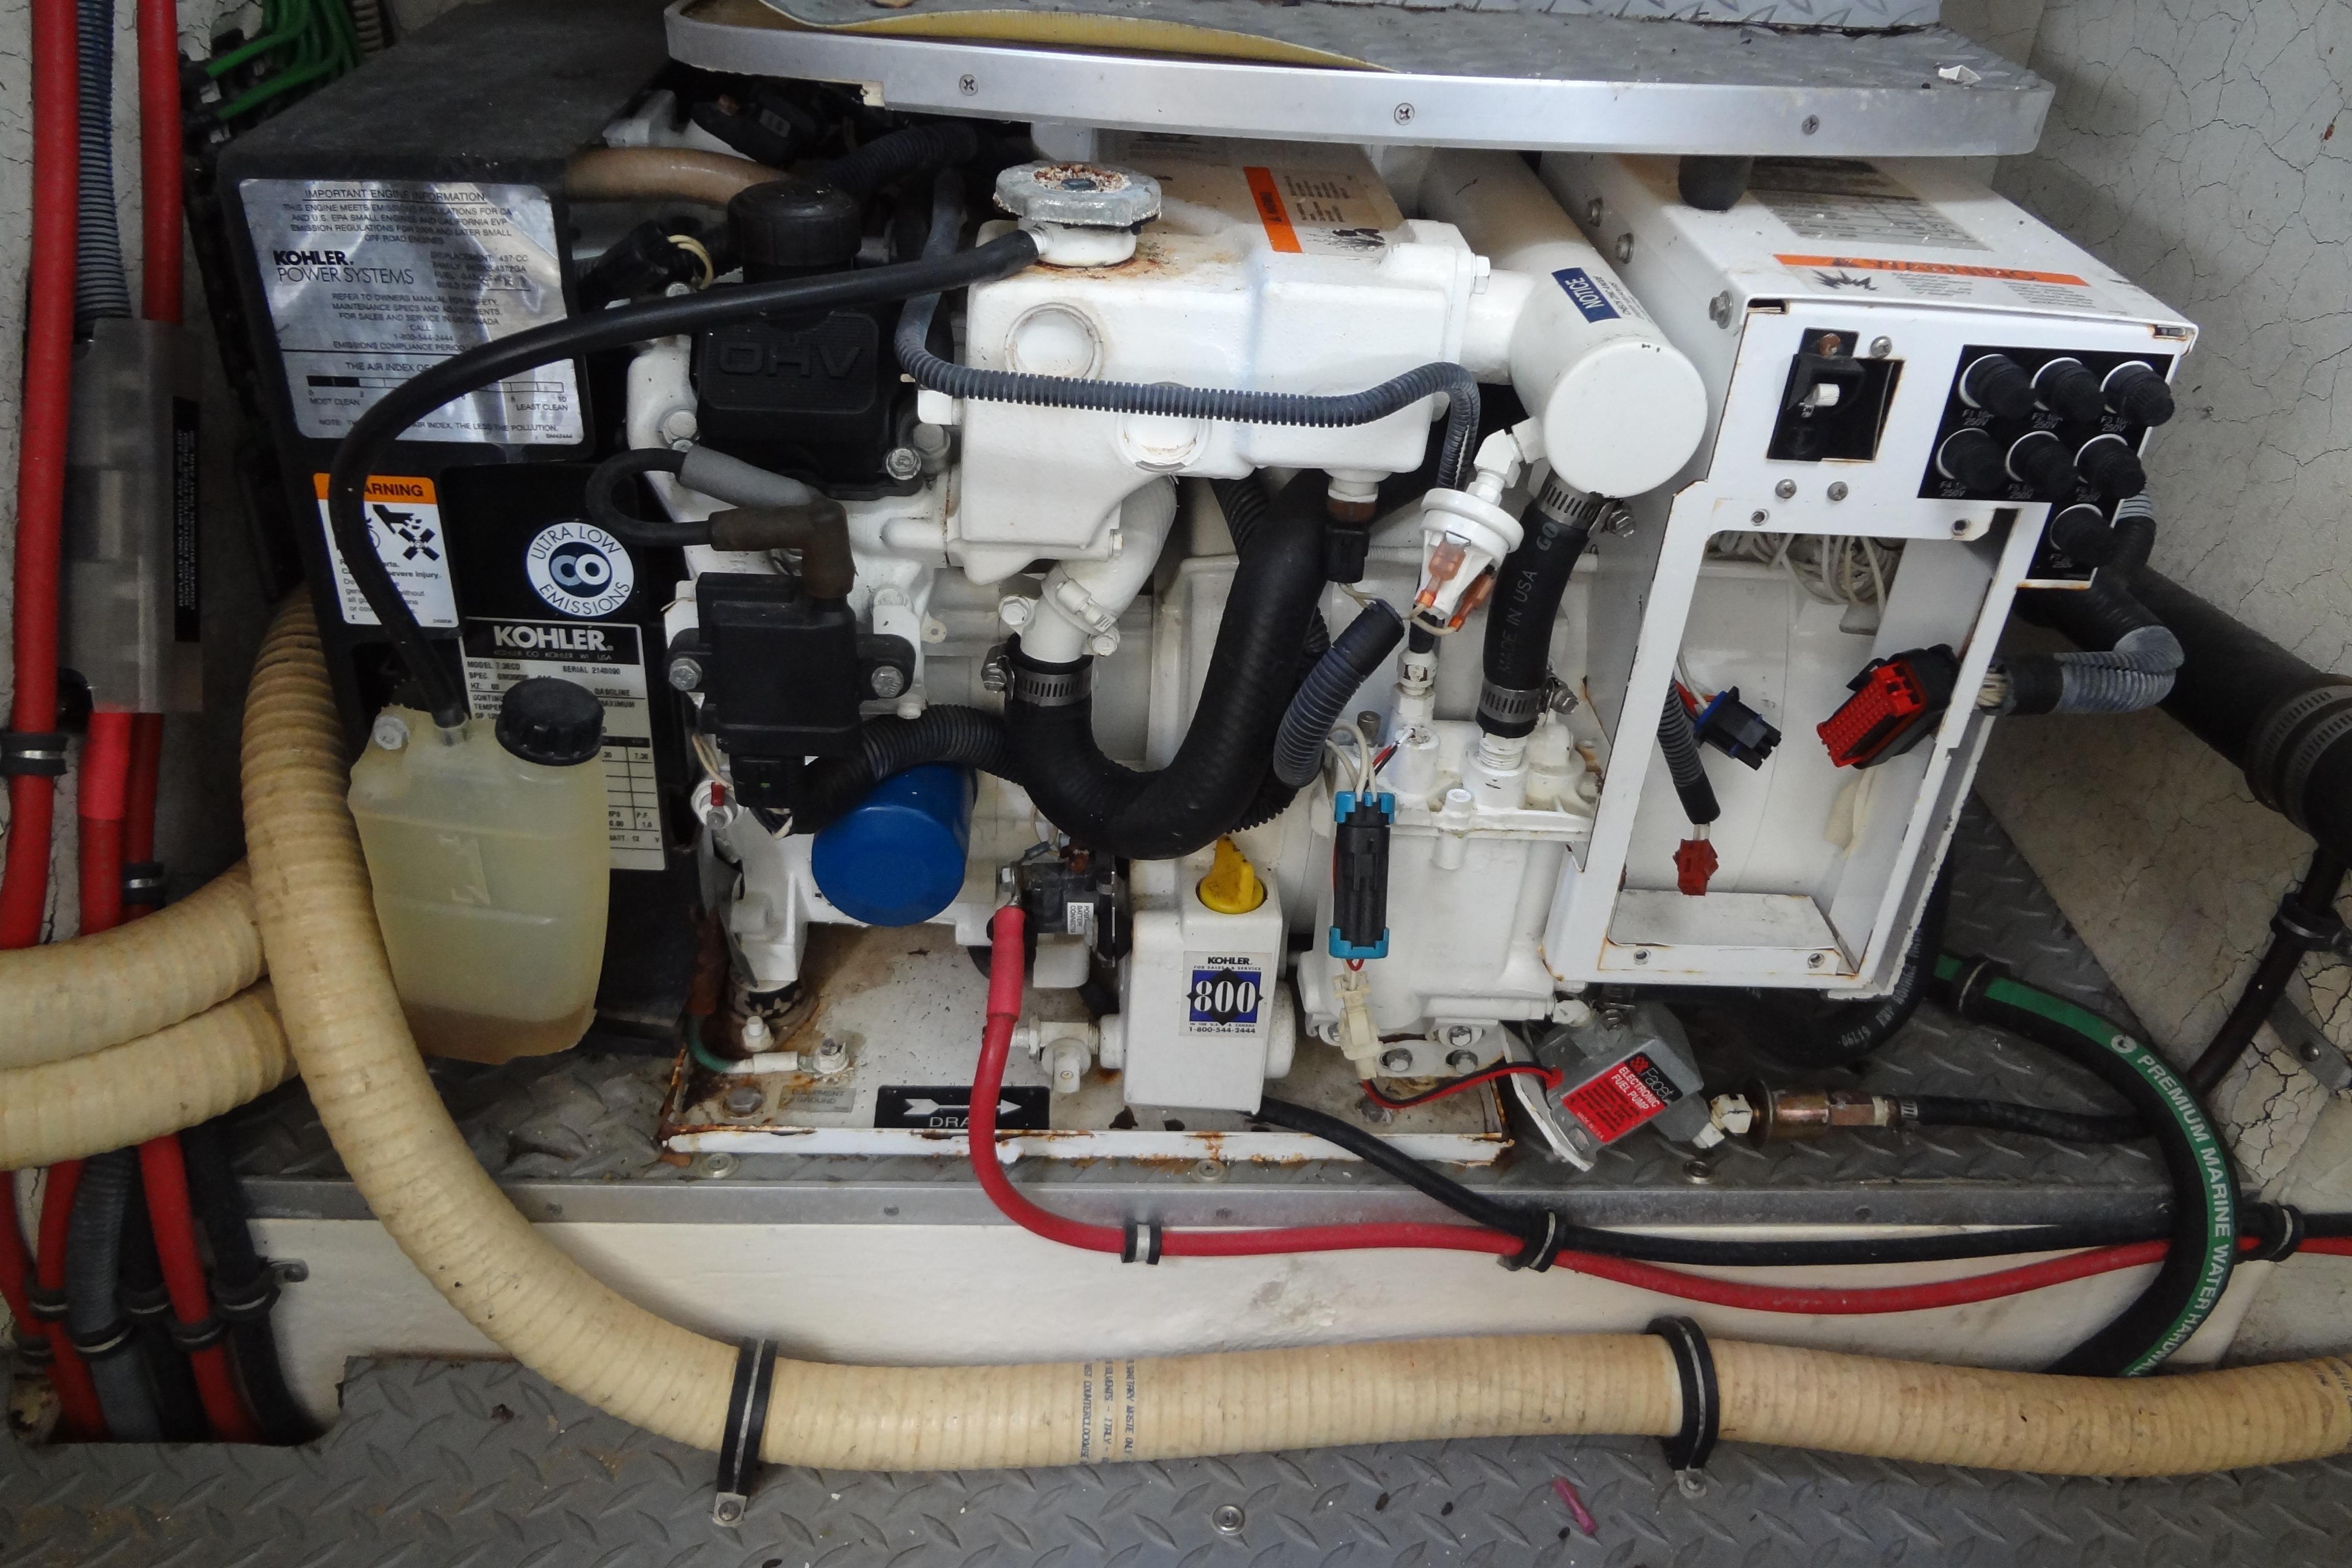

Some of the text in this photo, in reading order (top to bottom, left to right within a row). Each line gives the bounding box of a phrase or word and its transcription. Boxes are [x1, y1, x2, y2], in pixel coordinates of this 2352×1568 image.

[305, 189, 485, 201] IMPORTANT ENGINE INFORMATION
[277, 267, 414, 284] POWER SYSTEMS
[1565, 277, 1605, 309] NOTICE
[333, 341, 377, 349] EMISSIONS
[719, 341, 862, 379] OHV
[346, 362, 364, 370] THE
[368, 362, 382, 371] AIR
[386, 363, 414, 372] INDEX
[530, 525, 622, 560] ULTRA LOW
[539, 581, 631, 615] EMISSIONS
[1498, 570, 1538, 672] MADE IN USA
[467, 661, 493, 669] MODEL
[562, 665, 588, 673] SERIAL
[1194, 980, 1256, 1013] 800
[1611, 1074, 1628, 1093] FUEL
[1626, 1090, 1651, 1111] PUMP
[1618, 1065, 1661, 1108] ELECTRONIC
[1640, 1067, 1675, 1101] Facet
[2137, 1054, 2210, 1143] PREMIUM
[929, 1116, 970, 1128] DRA
[2199, 1146, 2232, 1237] MARINE
[2194, 1242, 2230, 1310] WATER
[2127, 1313, 2202, 1377] HARDWALL
[1103, 1417, 1113, 1444] ITALY
